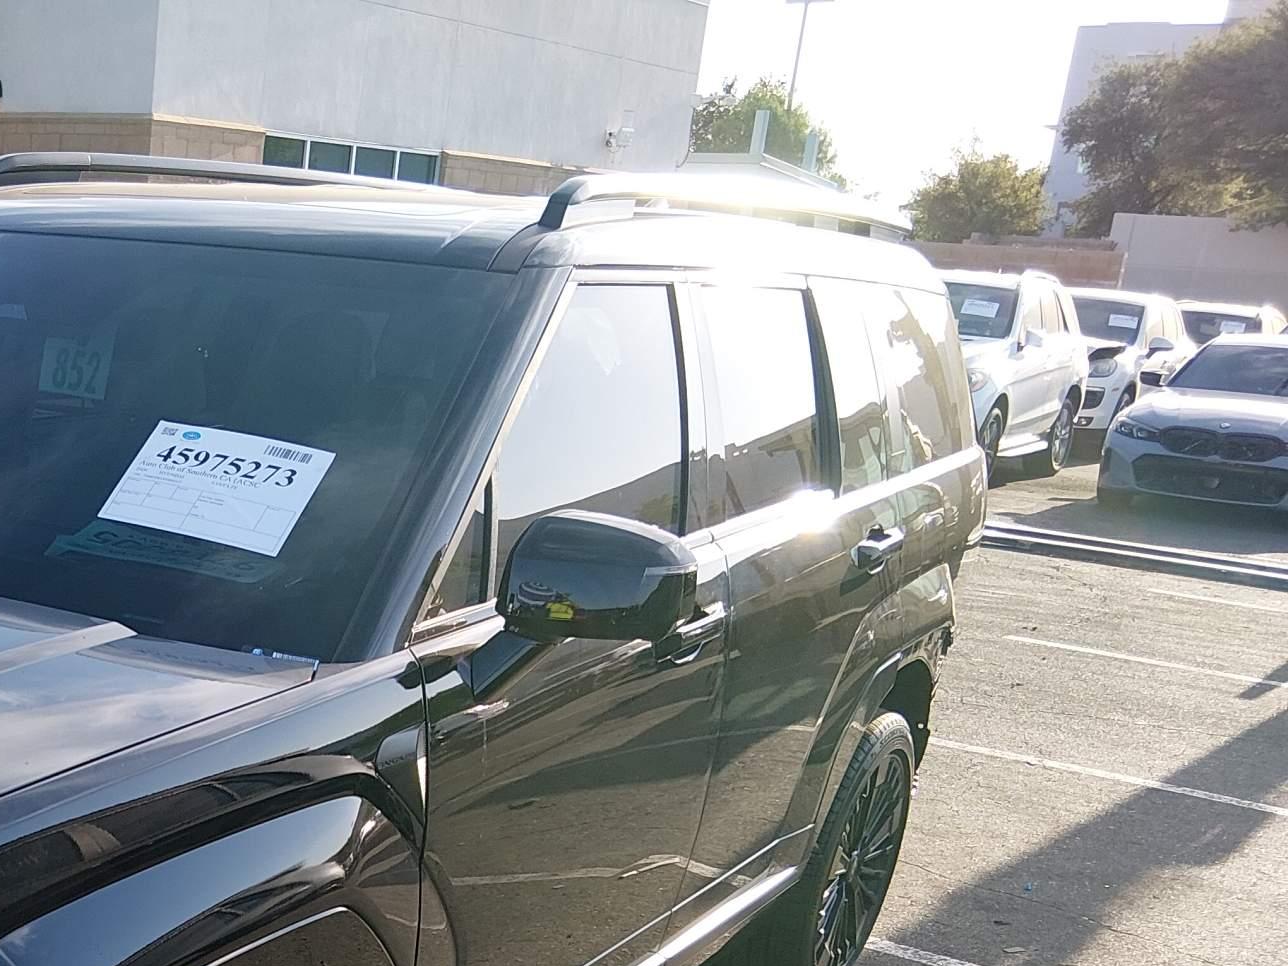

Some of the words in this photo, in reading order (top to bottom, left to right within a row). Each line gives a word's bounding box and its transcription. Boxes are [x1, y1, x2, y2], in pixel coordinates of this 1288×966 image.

[52, 347, 102, 395] 852
[139, 459, 158, 469] Auto
[158, 462, 176, 472] Club
[186, 466, 218, 480] Southern
[157, 445, 297, 487] 45975273
